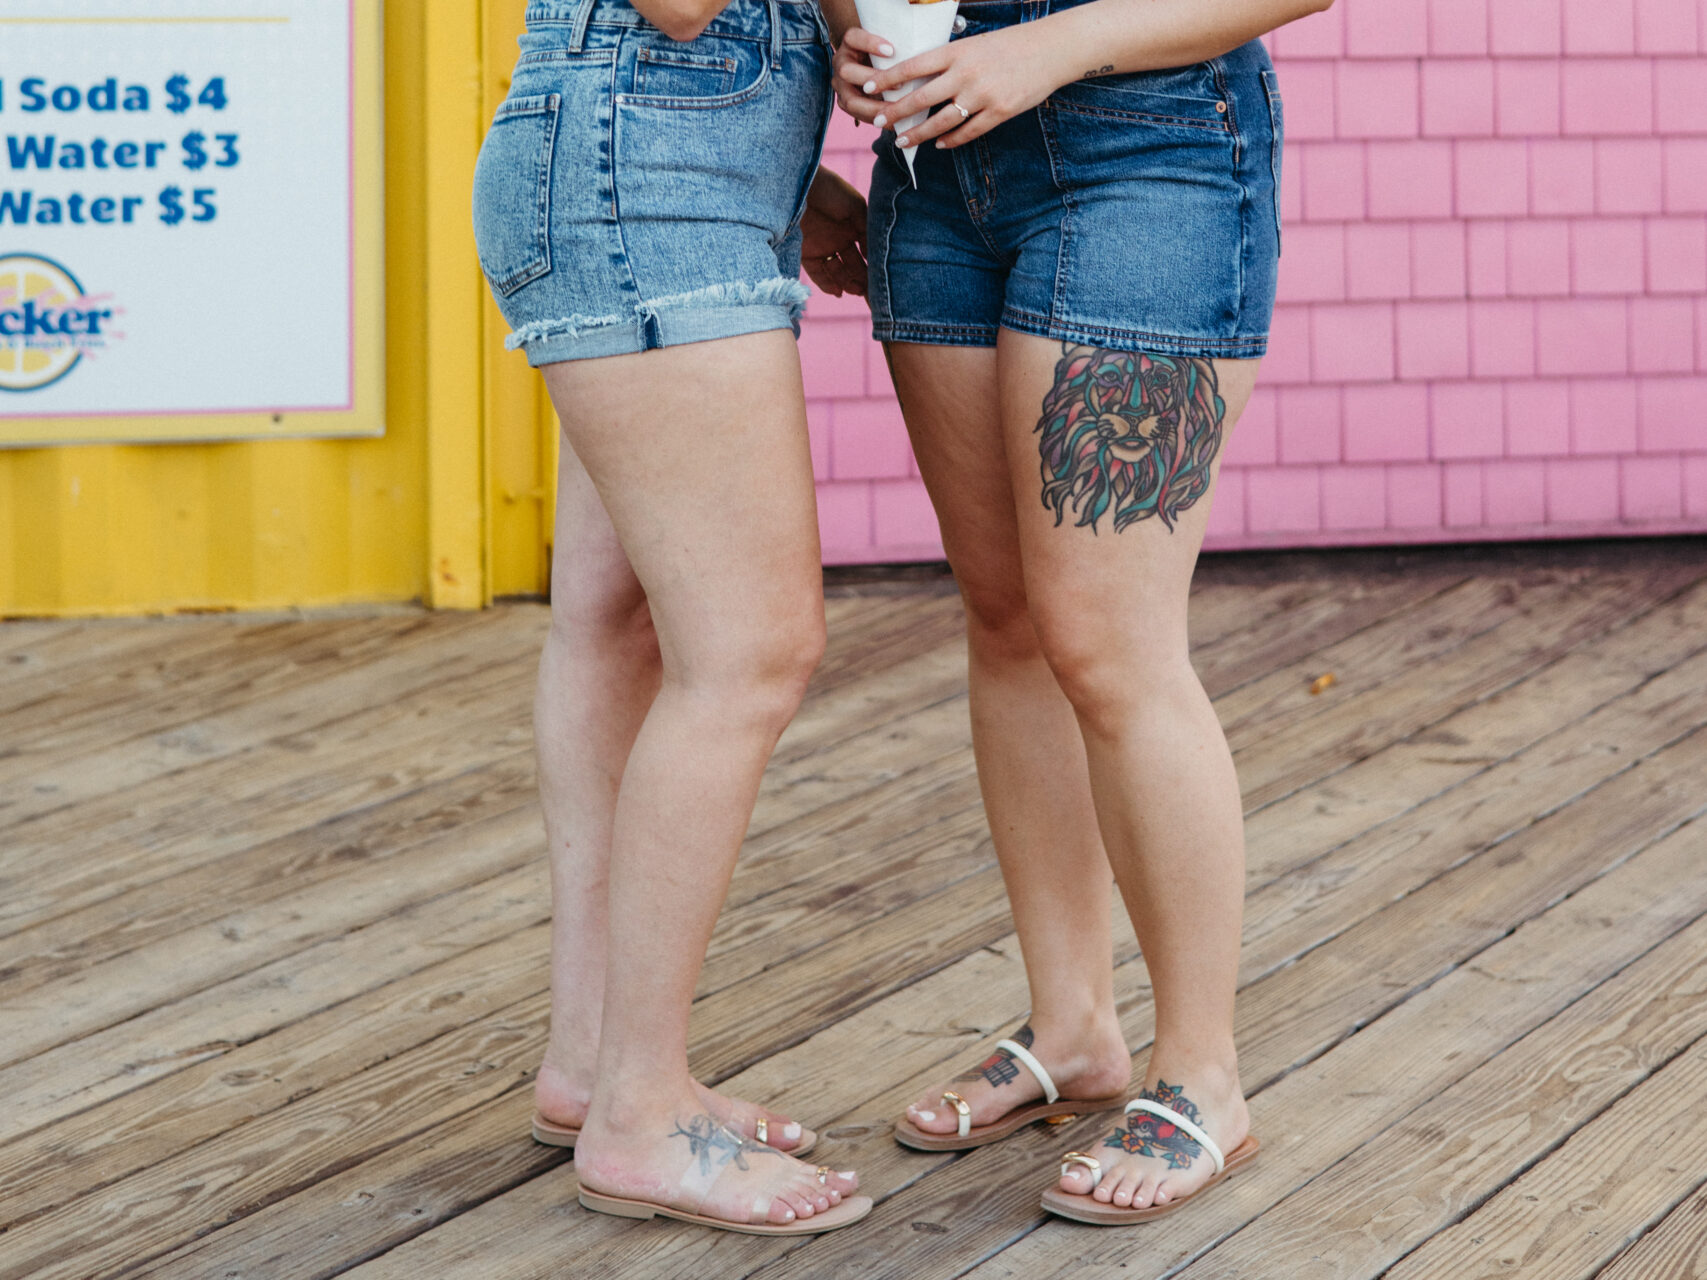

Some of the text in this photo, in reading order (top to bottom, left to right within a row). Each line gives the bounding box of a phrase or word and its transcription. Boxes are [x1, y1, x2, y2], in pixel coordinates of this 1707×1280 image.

[20, 78, 149, 113] Soda
[165, 74, 228, 114] $4
[7, 131, 239, 171] Water $3
[0, 186, 217, 226] Water $5
